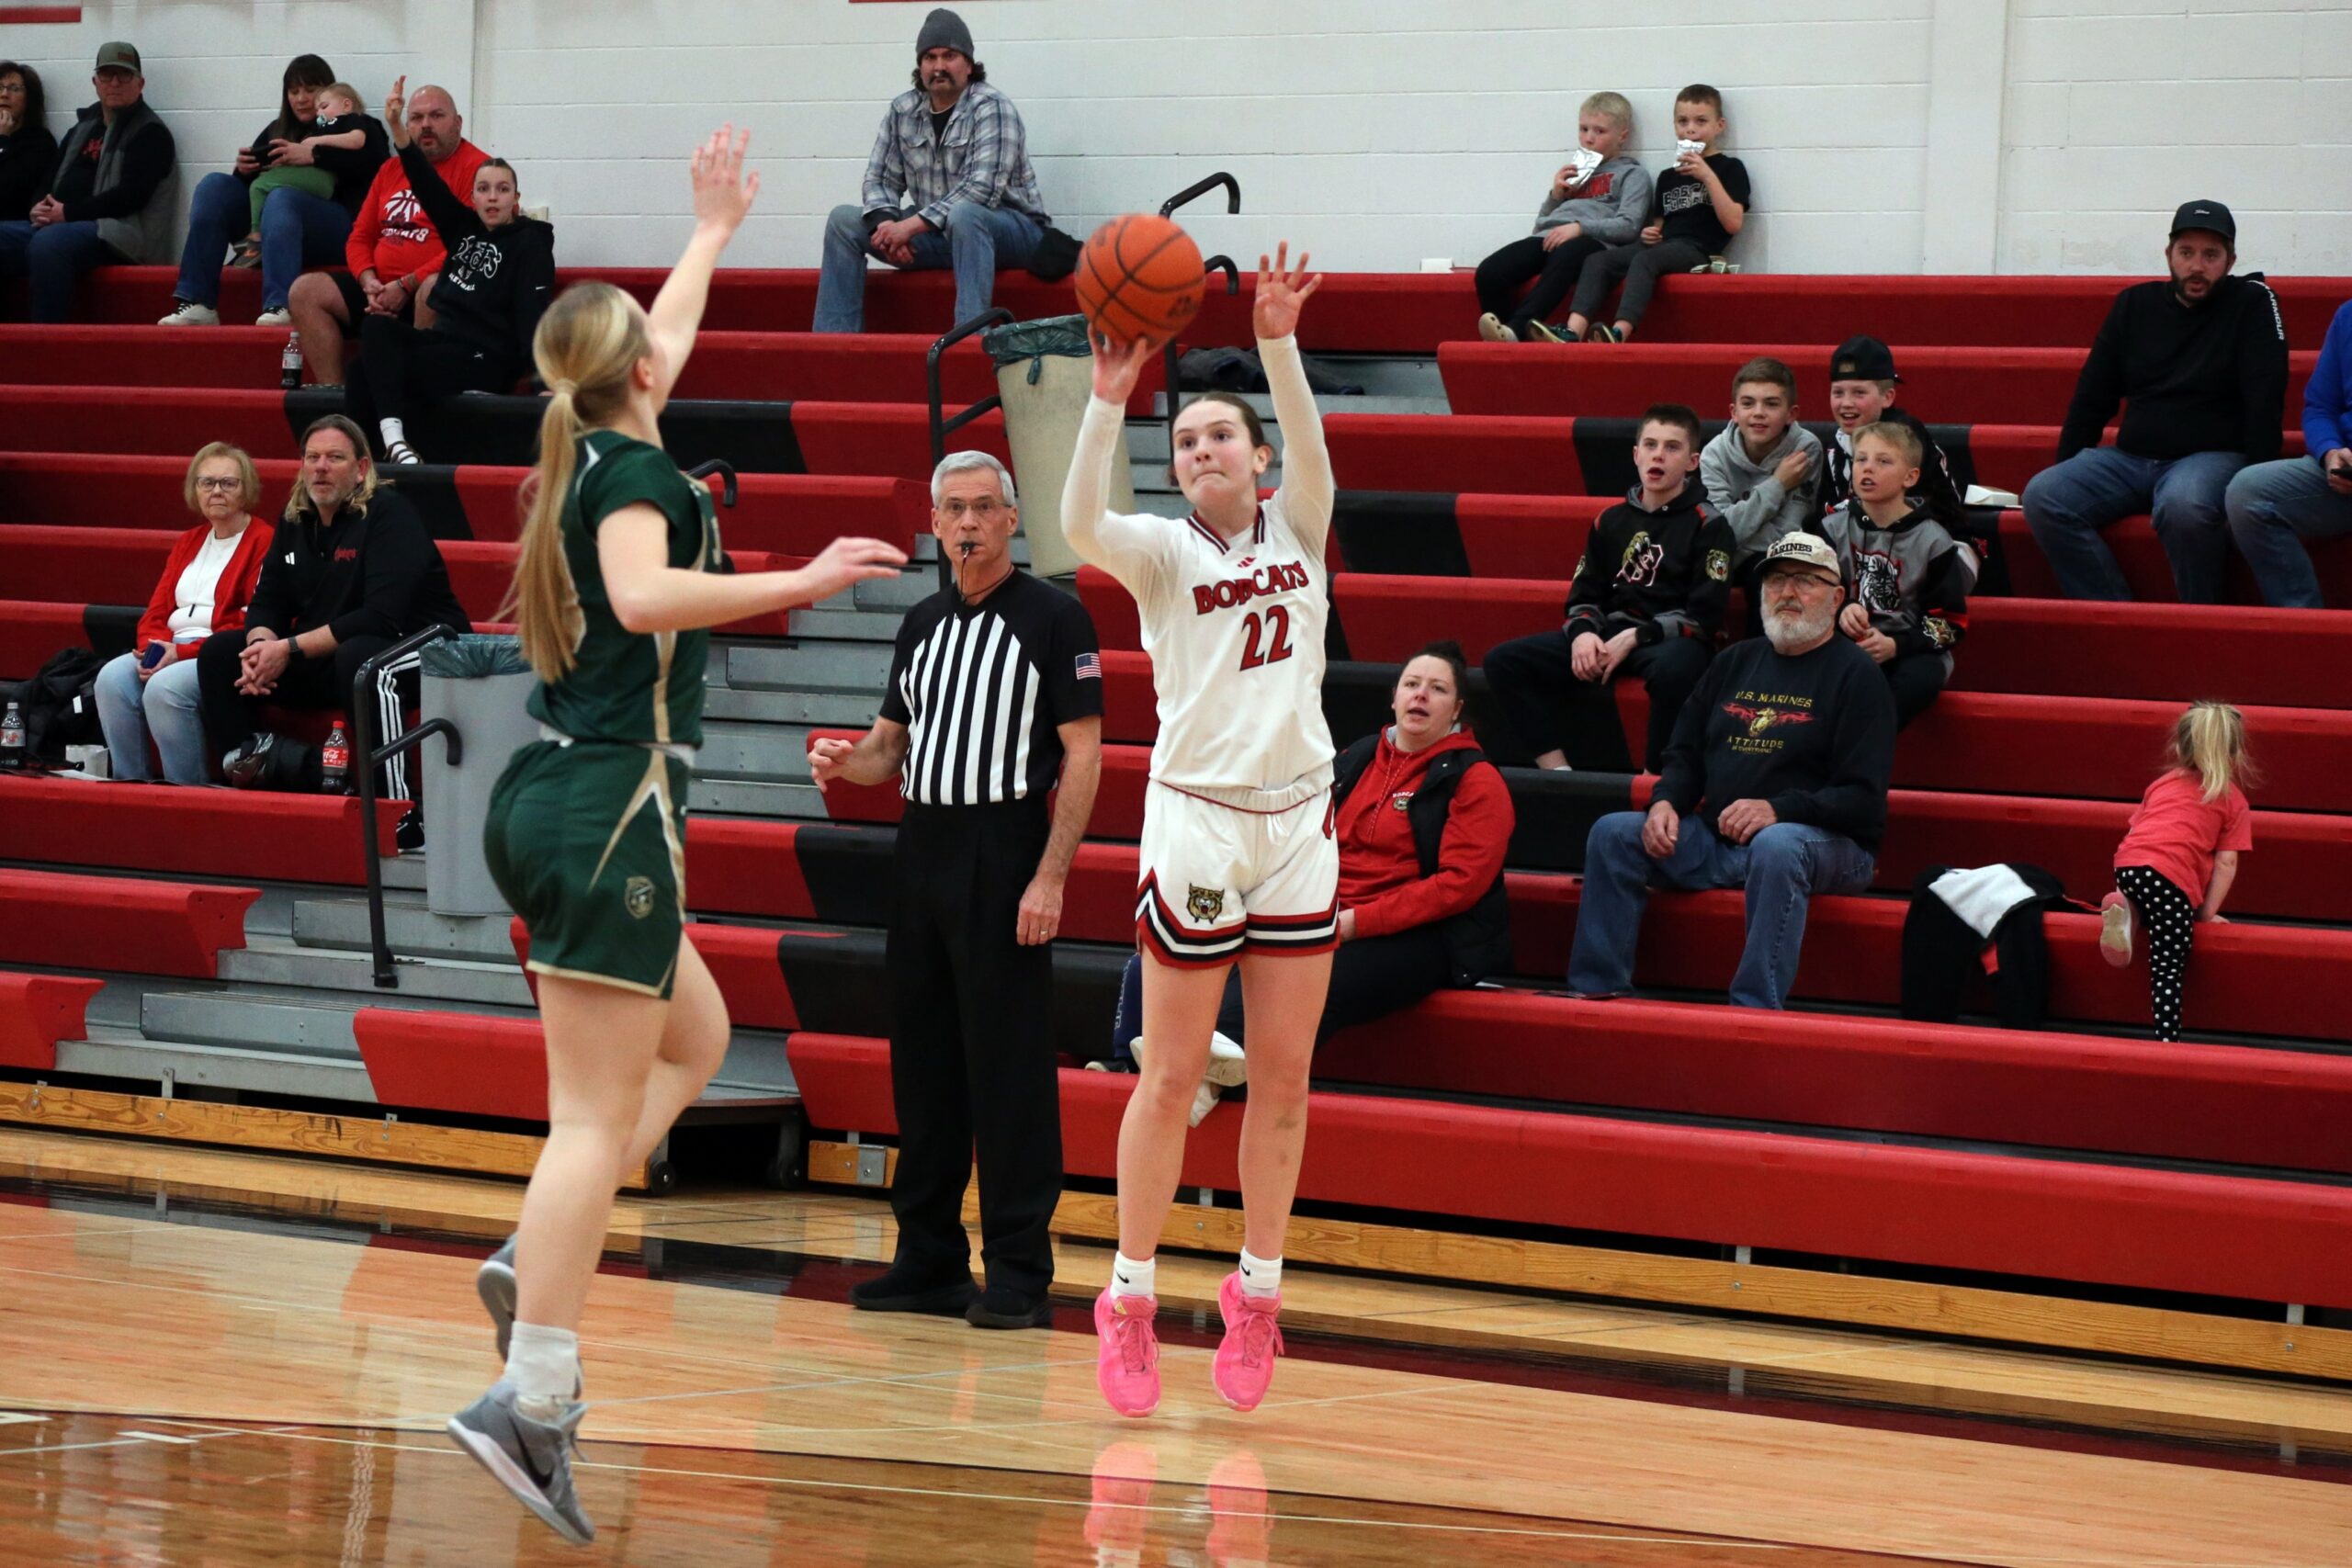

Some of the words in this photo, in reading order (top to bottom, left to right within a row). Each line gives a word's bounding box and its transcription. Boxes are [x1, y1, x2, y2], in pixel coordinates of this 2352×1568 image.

[1193, 560, 1309, 615] BOBCATS
[1238, 604, 1294, 671] 22
[1735, 690, 1756, 702] U.S.
[1757, 693, 1814, 708] MARINES
[1727, 735, 1784, 750] ATTITUDE
